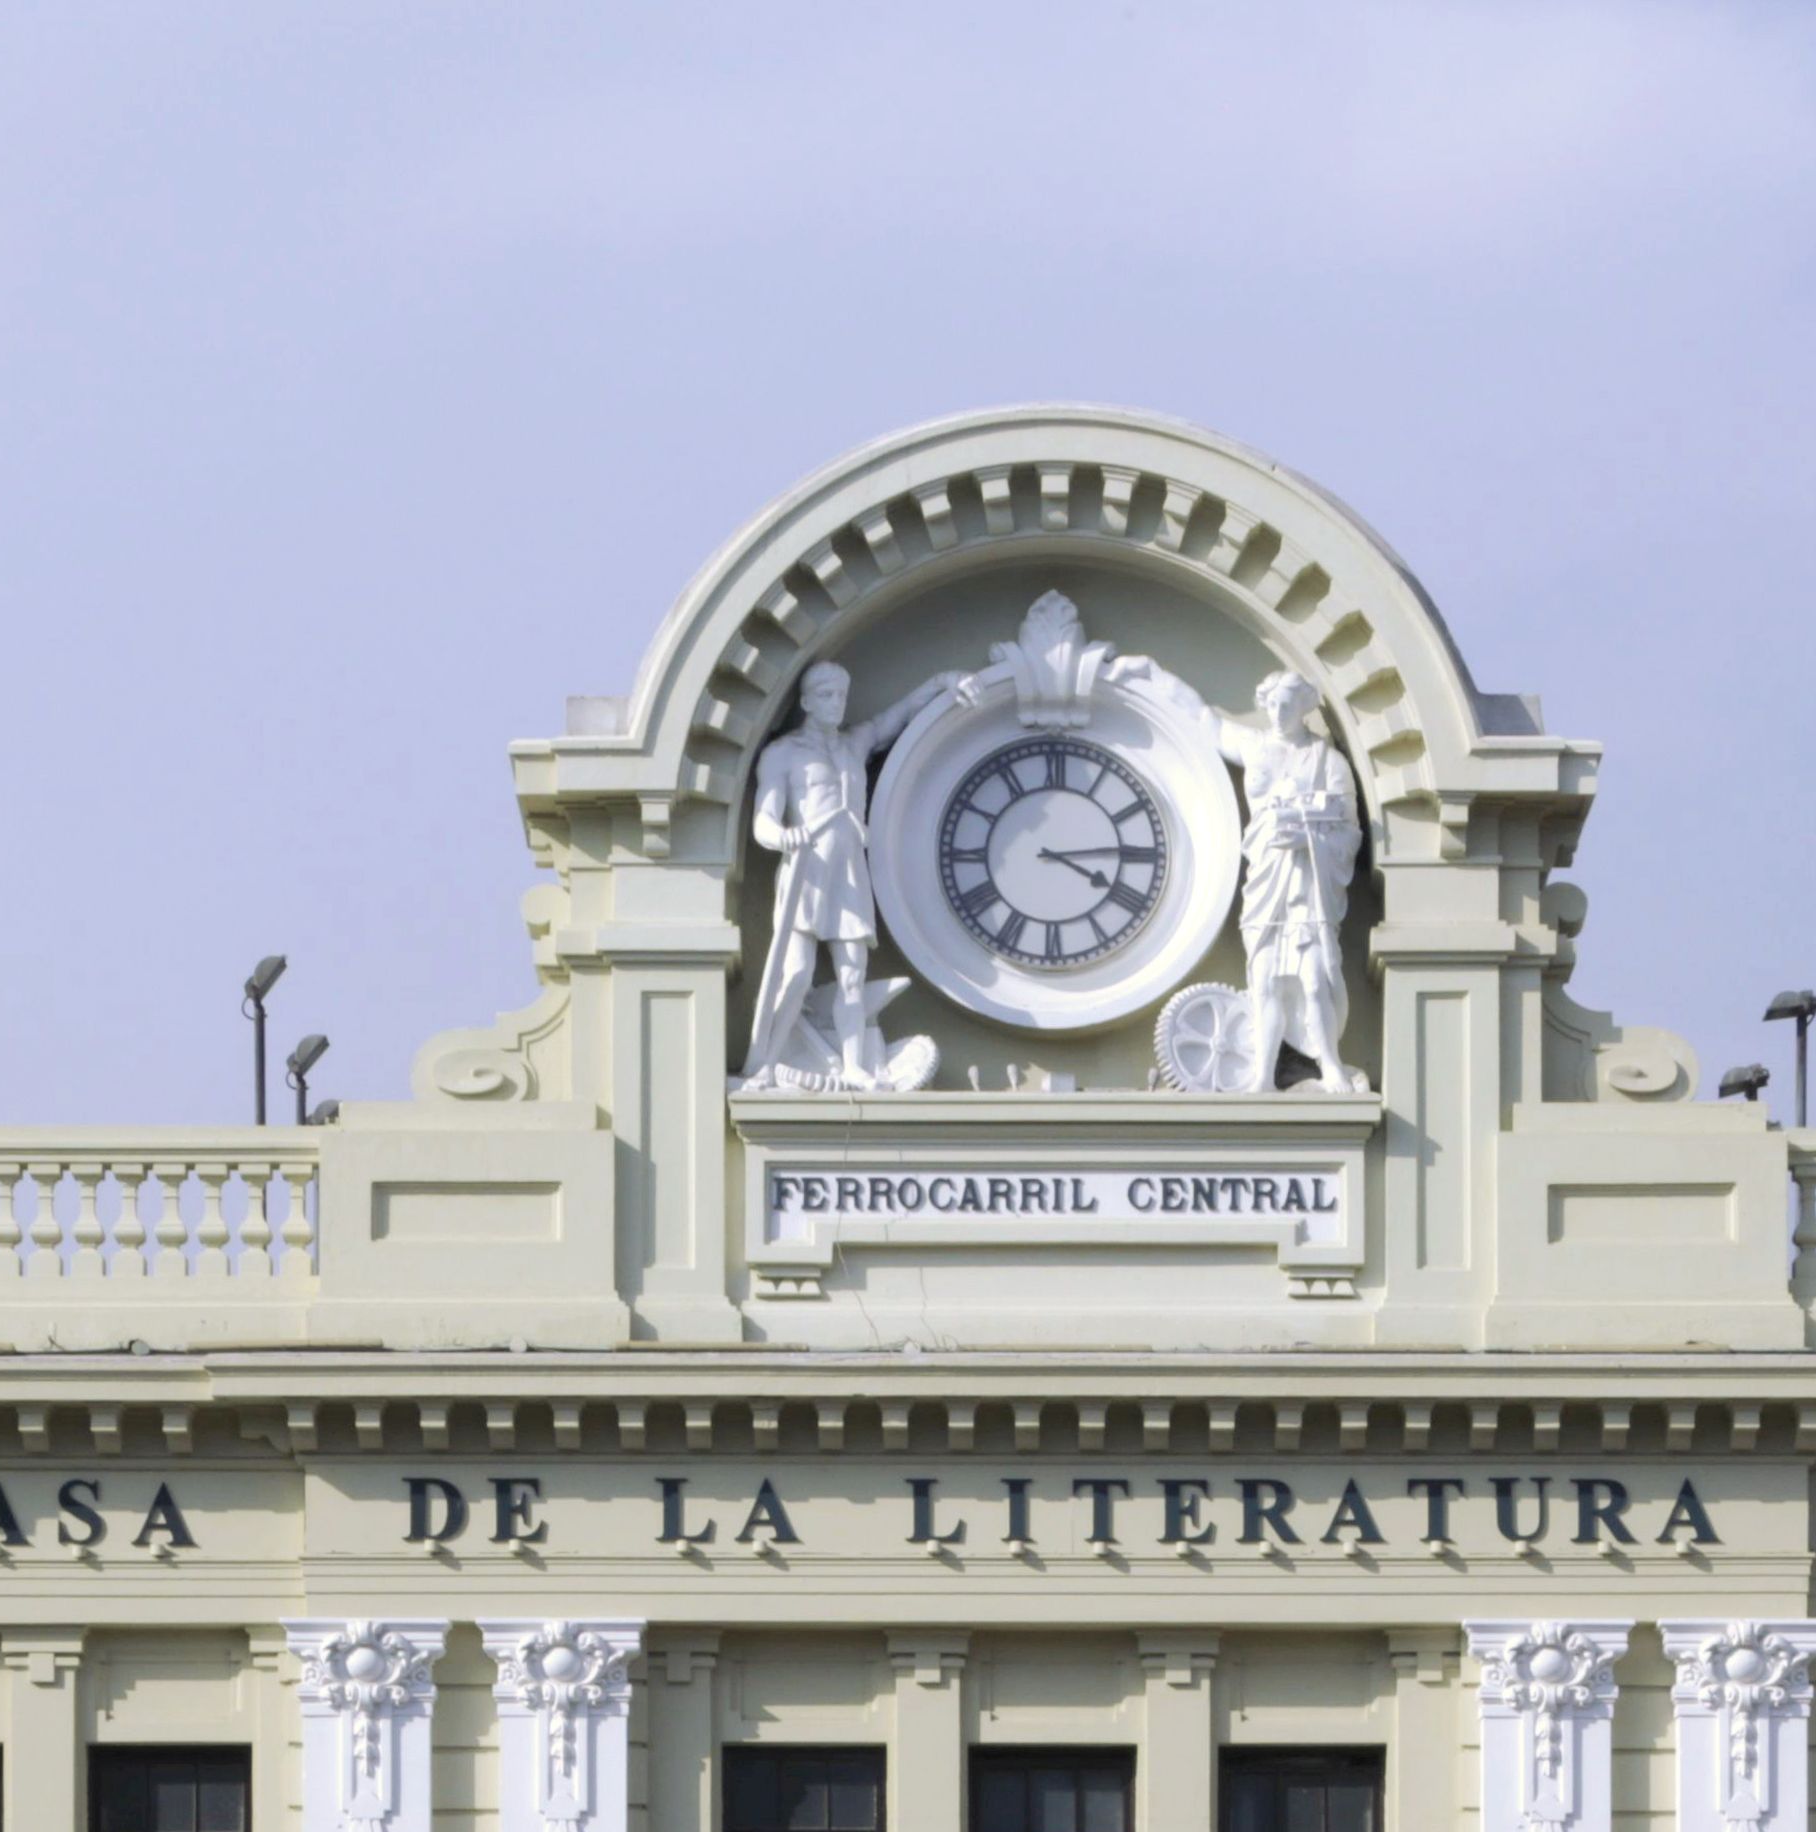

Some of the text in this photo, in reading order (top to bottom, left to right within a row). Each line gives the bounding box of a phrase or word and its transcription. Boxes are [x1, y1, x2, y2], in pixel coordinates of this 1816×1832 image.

[772, 1176, 1337, 1211] FERROCARRIL CENTRAL
[402, 1477, 547, 1545] DE
[656, 1477, 800, 1545] LA
[906, 1477, 1721, 1546] LITERATURA
